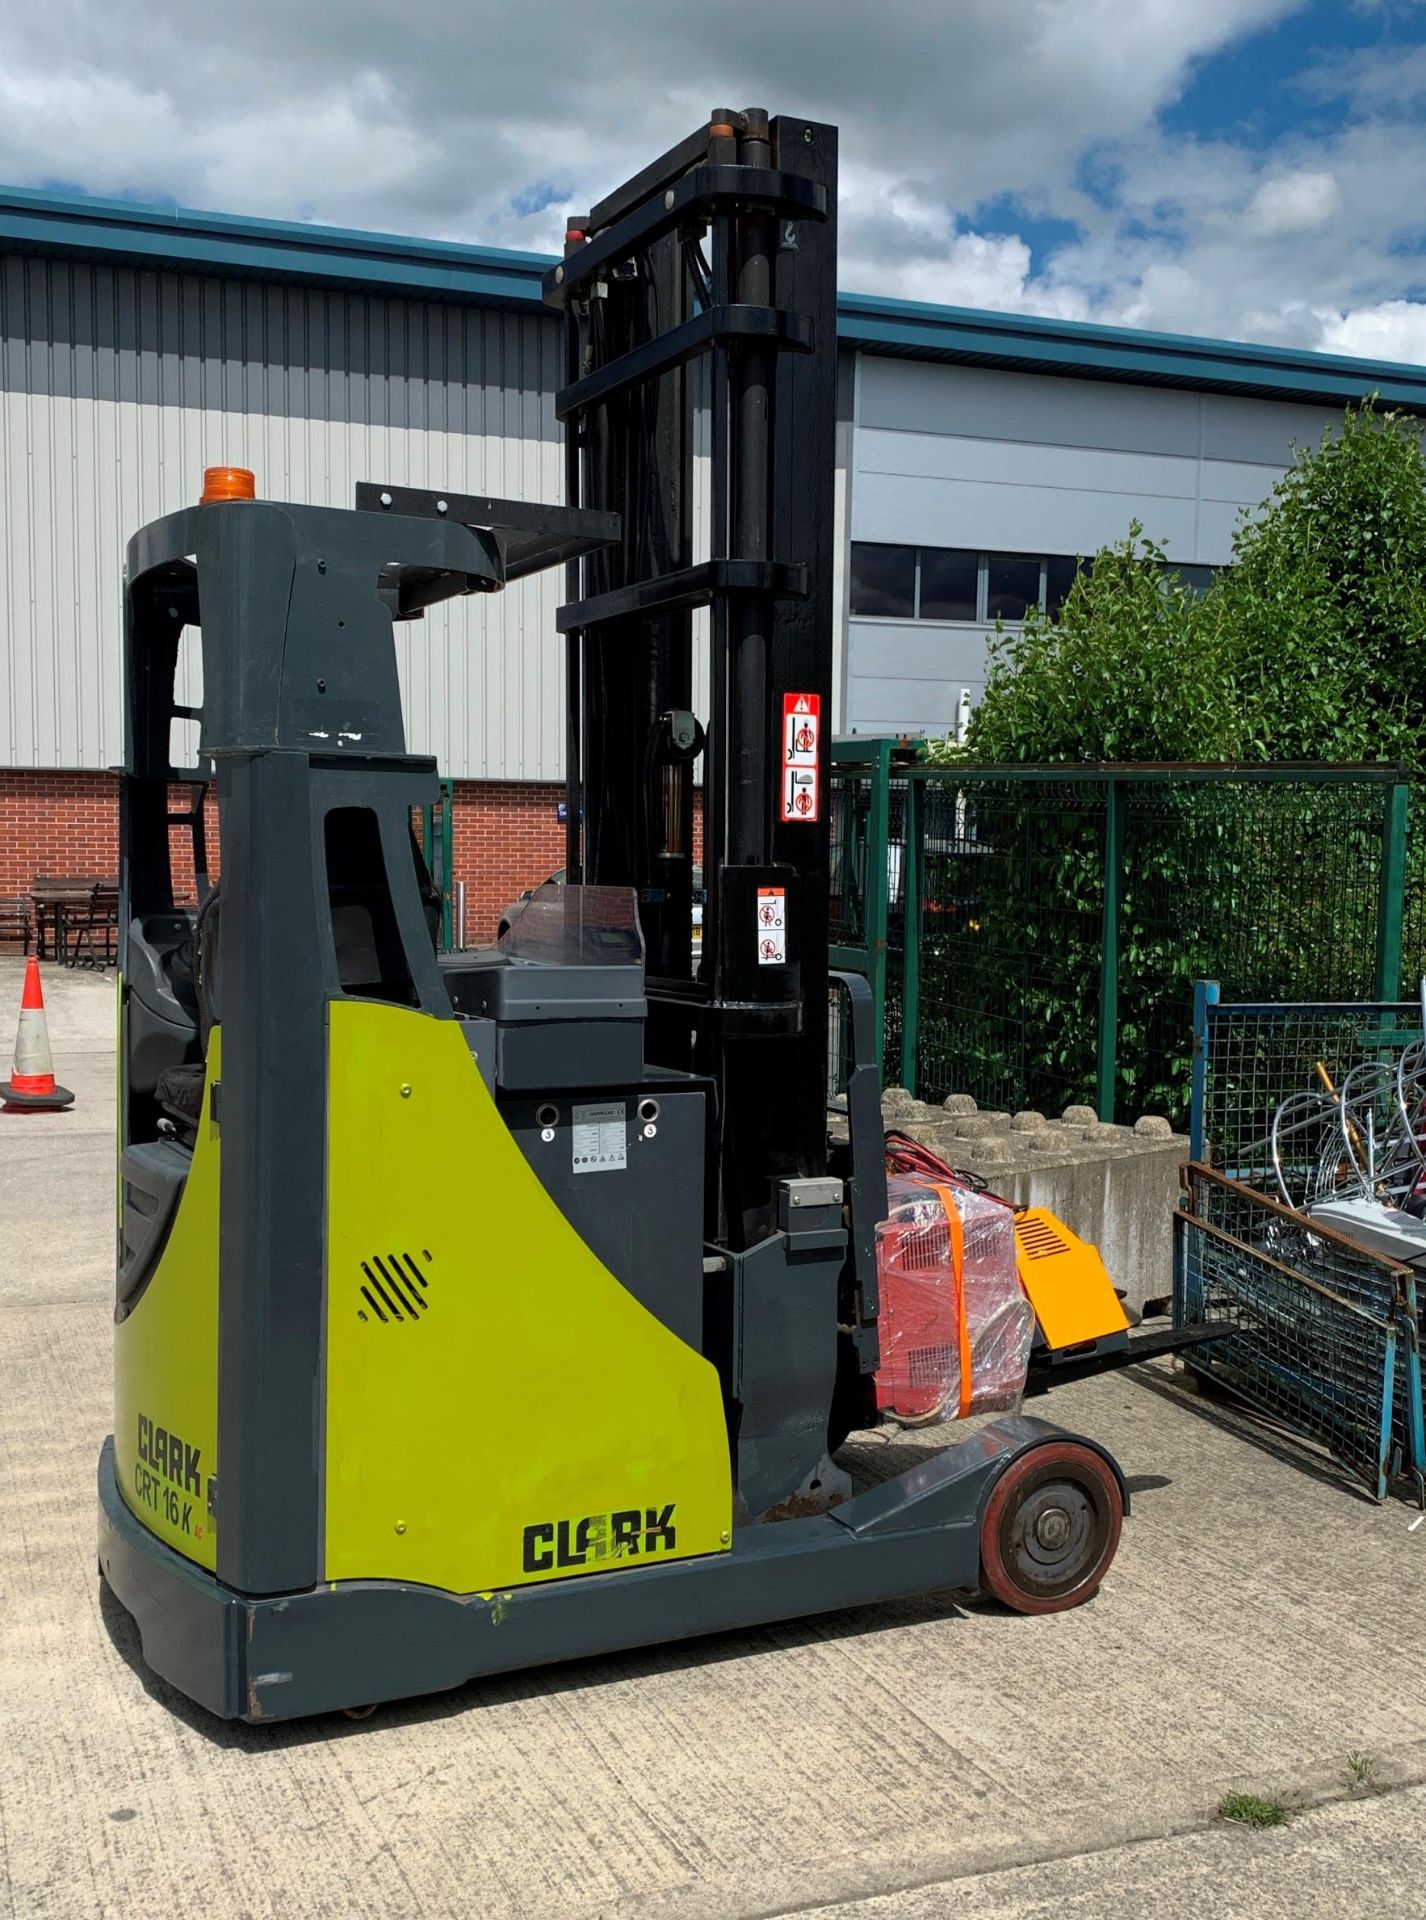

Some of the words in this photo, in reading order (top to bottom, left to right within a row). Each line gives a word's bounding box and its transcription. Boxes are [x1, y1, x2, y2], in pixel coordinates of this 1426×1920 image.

[138, 1412, 201, 1497] CLARK
[134, 1463, 160, 1511] CRT
[163, 1486, 179, 1525] 16
[182, 1502, 192, 1534] K
[523, 1503, 676, 1573] CLARK
